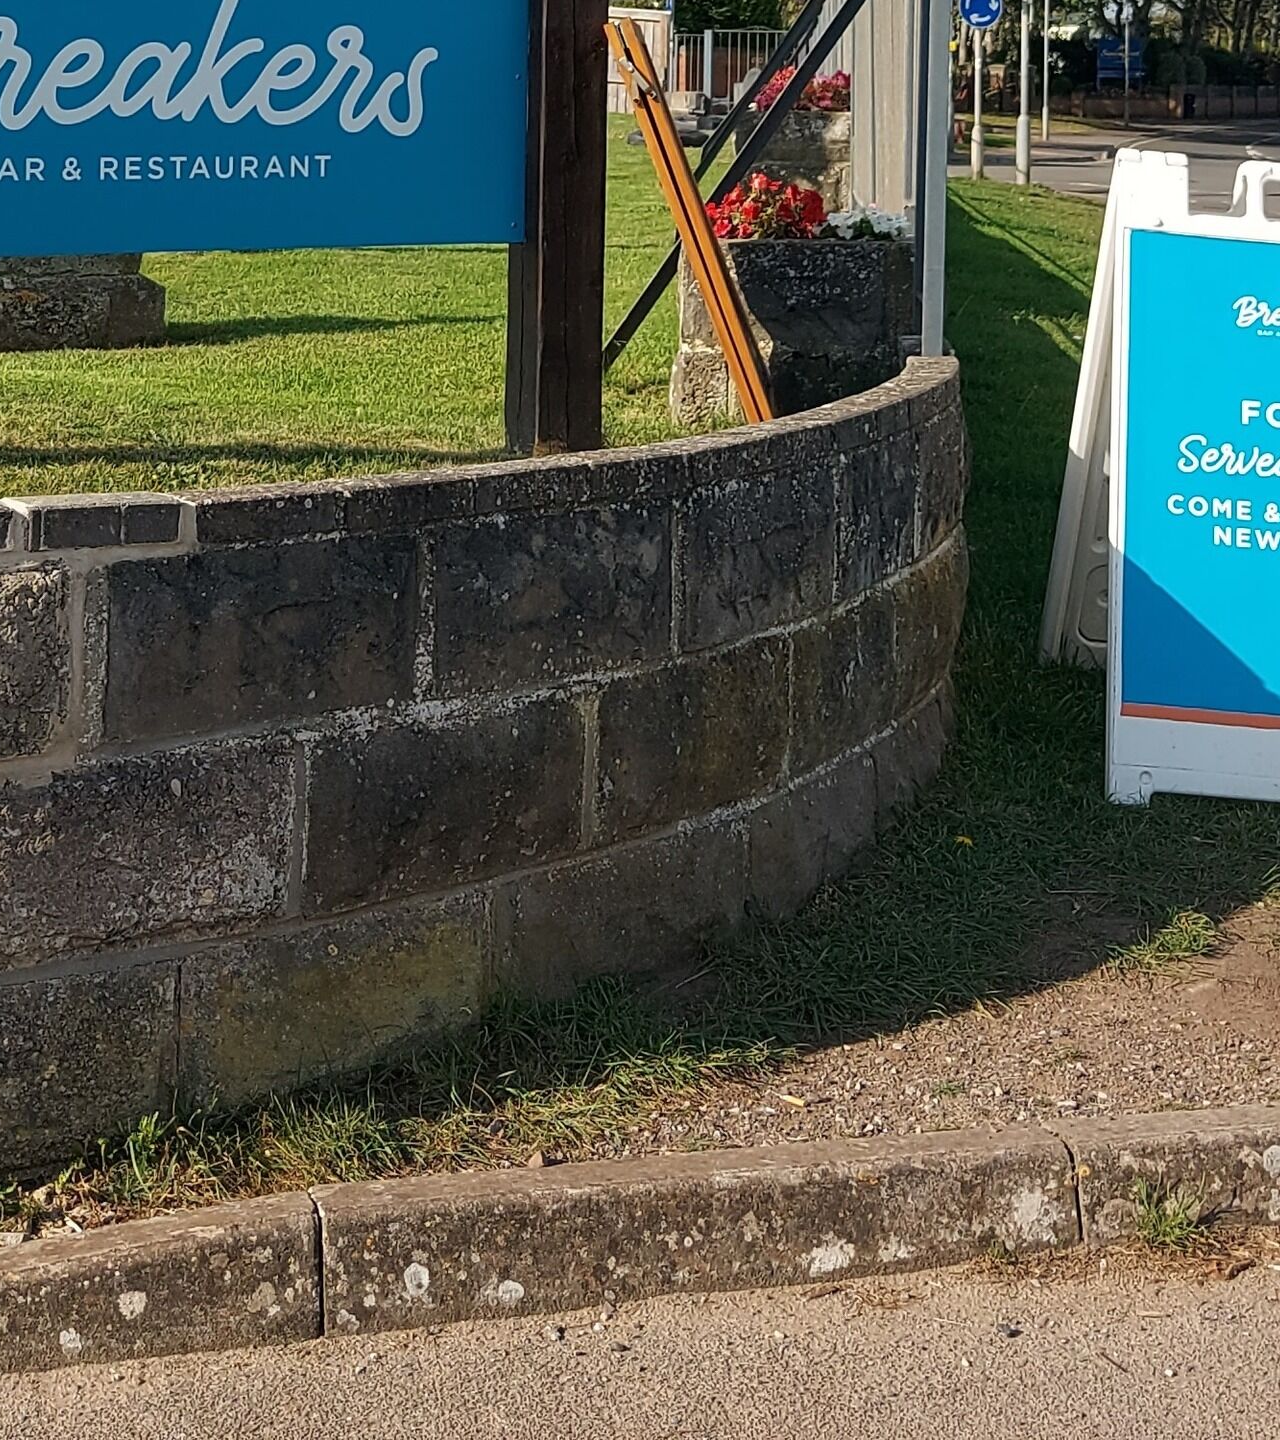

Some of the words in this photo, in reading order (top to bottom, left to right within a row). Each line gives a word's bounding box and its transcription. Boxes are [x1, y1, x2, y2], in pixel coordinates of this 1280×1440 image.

[62, 157, 82, 181] &
[99, 155, 332, 181] RESTAURANT
[1167, 494, 1253, 522] COME
